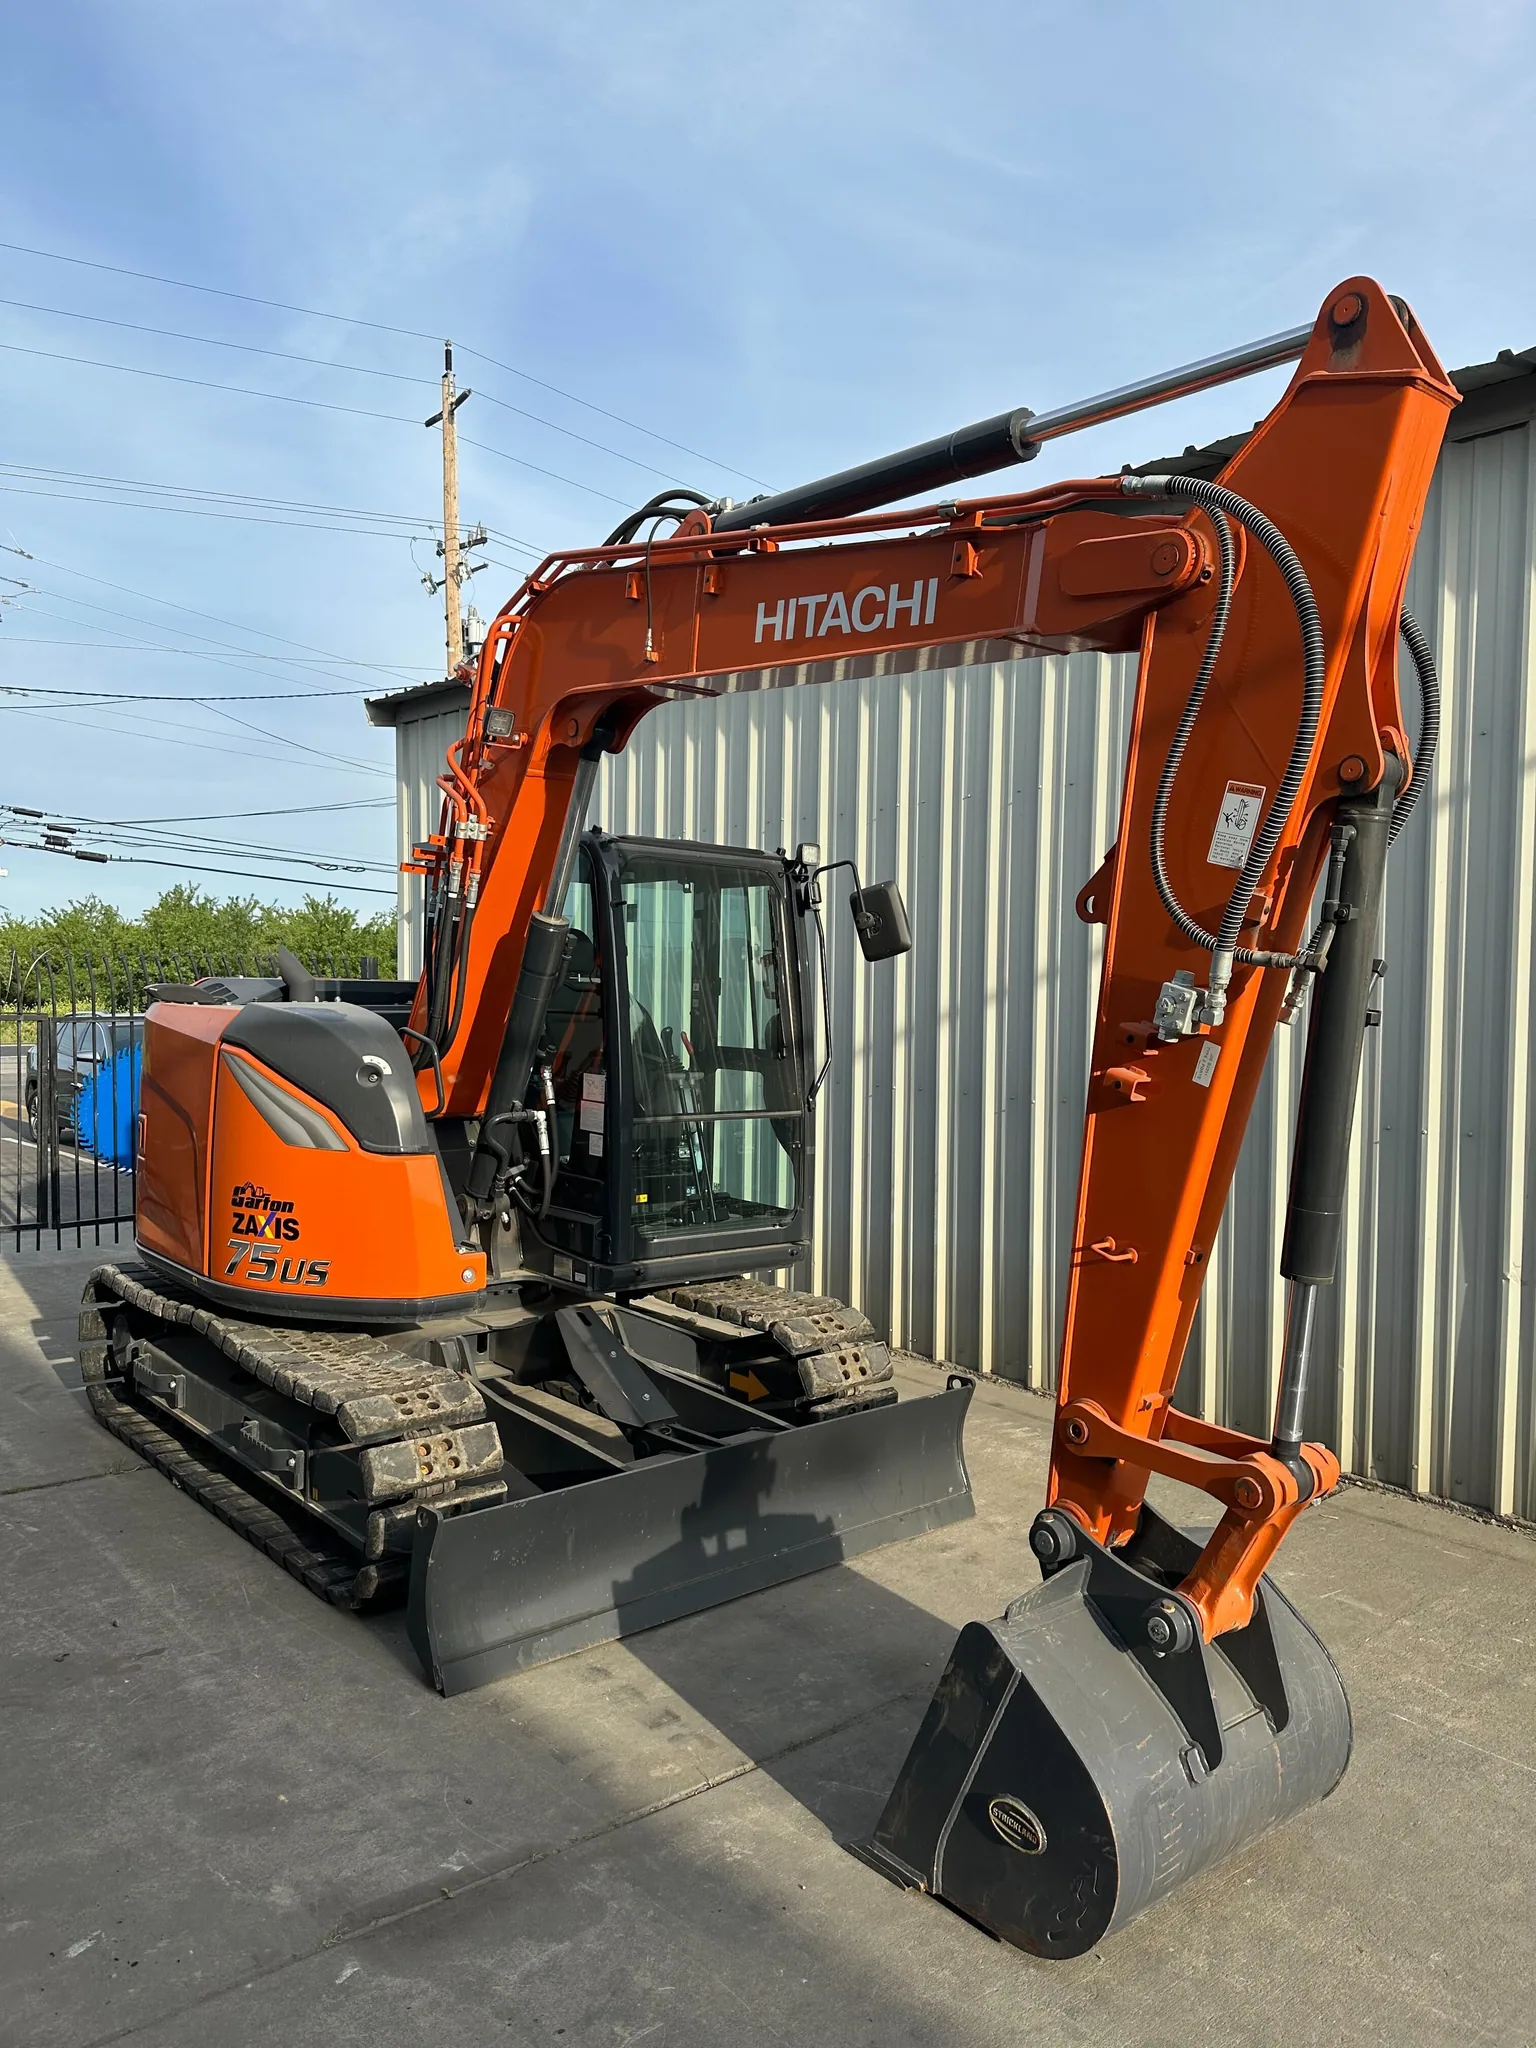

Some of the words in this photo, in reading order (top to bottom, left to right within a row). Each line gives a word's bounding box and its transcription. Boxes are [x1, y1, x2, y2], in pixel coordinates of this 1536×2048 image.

[754, 577, 939, 643] HITACHI
[1235, 787, 1261, 797] WARNING
[231, 1186, 295, 1213] Garton
[232, 1212, 300, 1241] ZAXIS
[992, 1807, 1037, 1844] STRICKLAND
